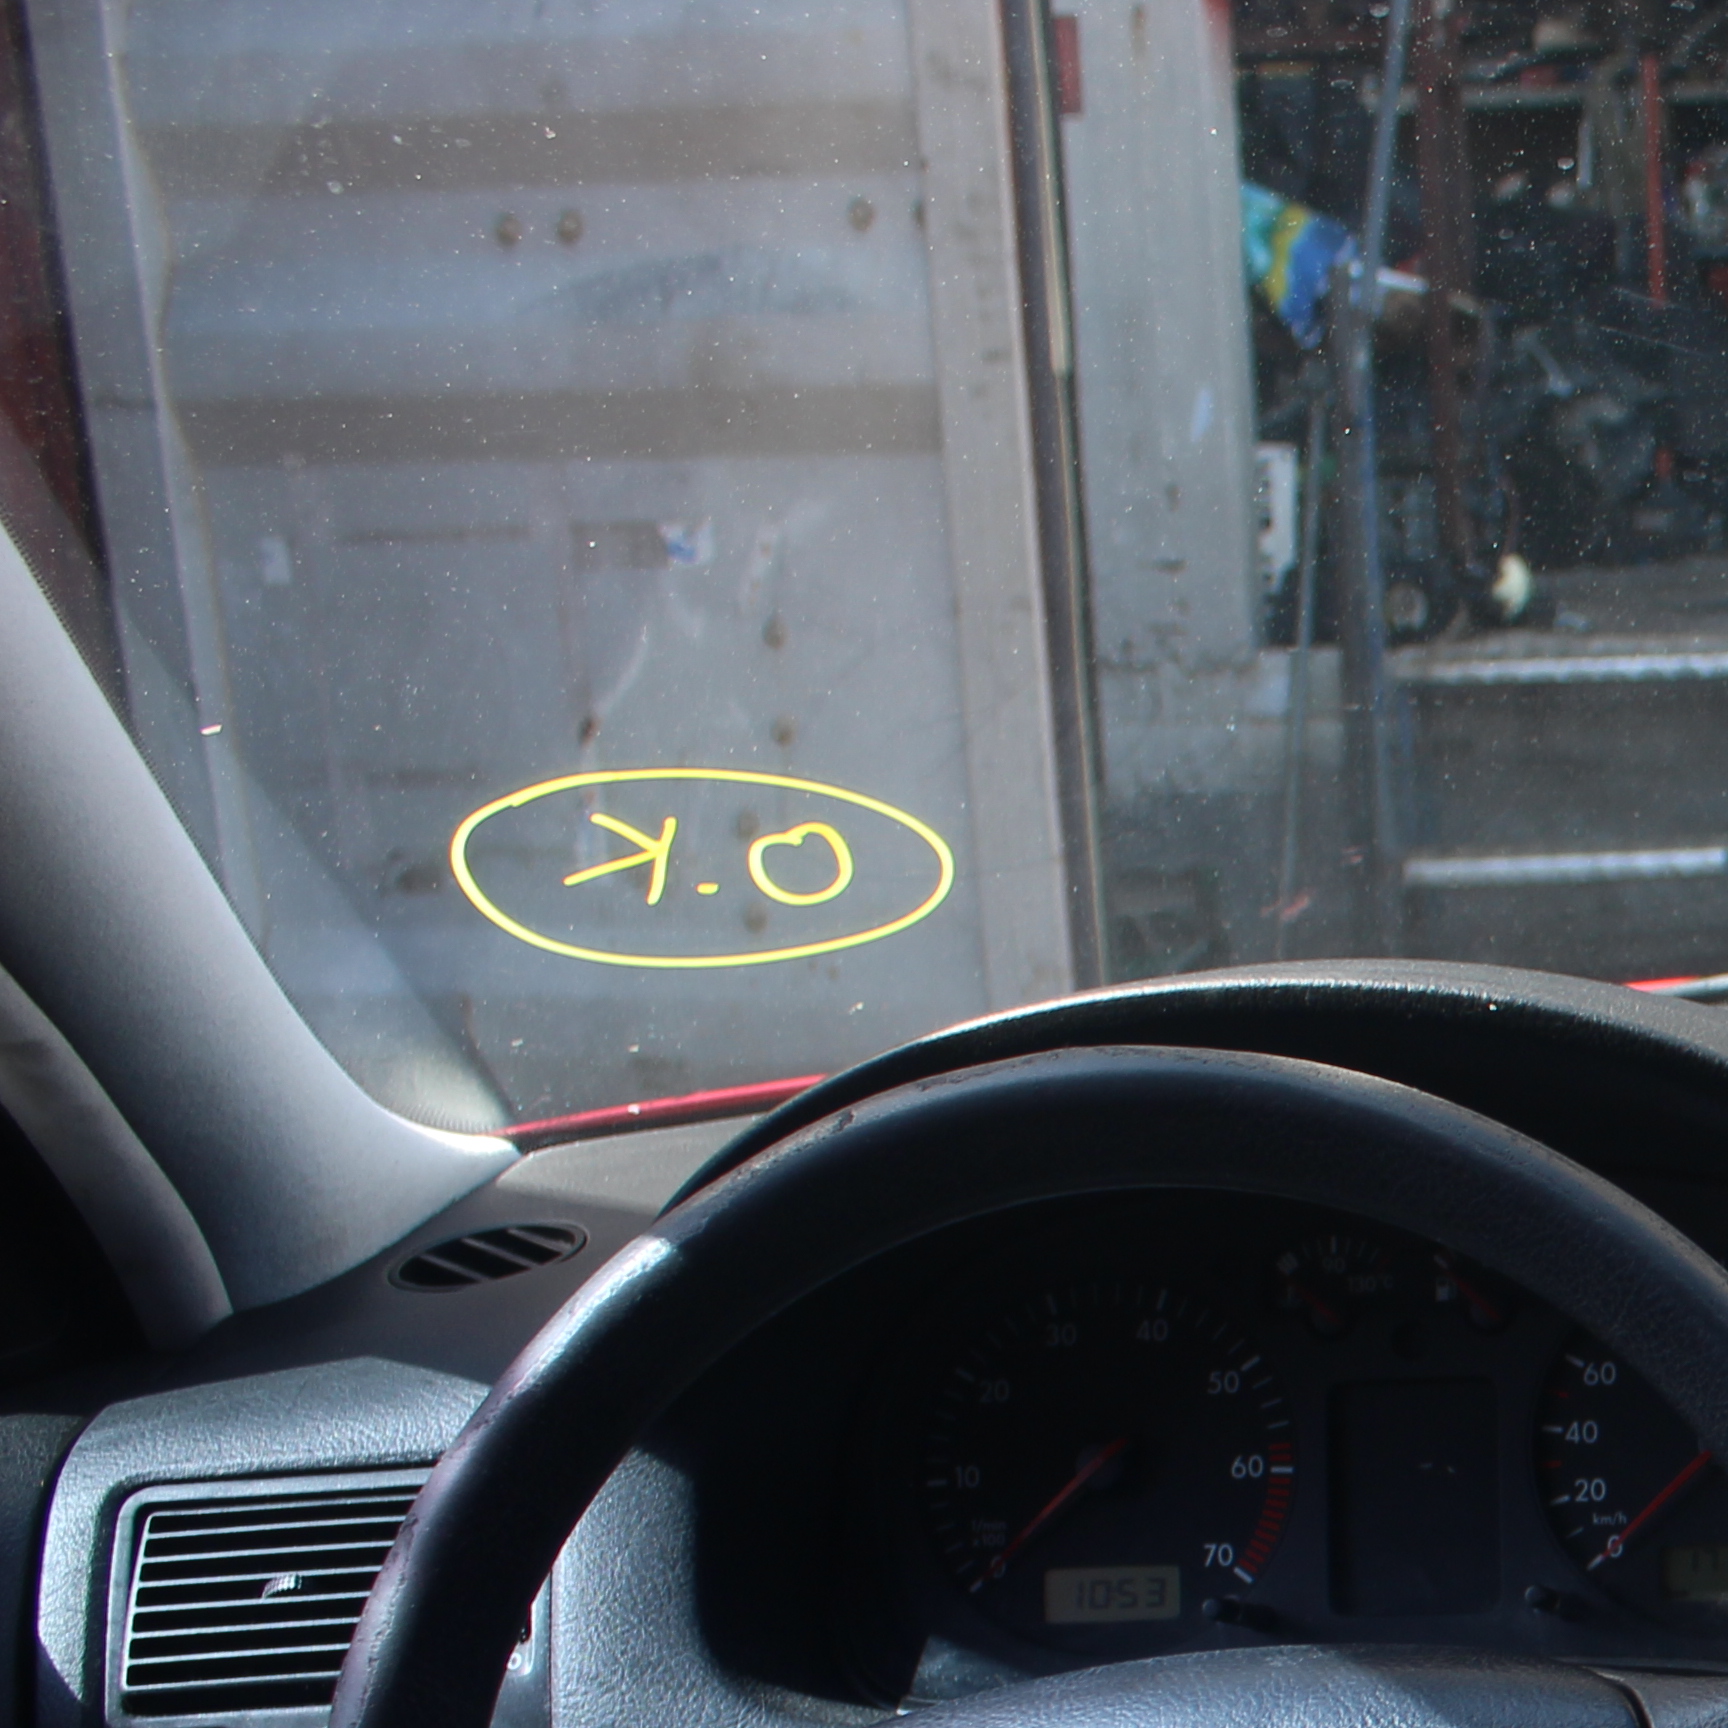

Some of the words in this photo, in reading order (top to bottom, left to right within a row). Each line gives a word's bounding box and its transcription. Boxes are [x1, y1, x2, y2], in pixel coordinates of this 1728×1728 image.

[1045, 1323, 1077, 1347] 30
[1136, 1319, 1169, 1343] 40
[1208, 1371, 1240, 1395] 50
[1583, 1362, 1616, 1386] 60
[979, 1380, 1011, 1404] 20
[1565, 1421, 1599, 1445] 40
[955, 1465, 980, 1490] 10
[1231, 1455, 1264, 1479] 60
[1575, 1478, 1607, 1503] 20
[1592, 1511, 1628, 1527] km/h
[1203, 1543, 1234, 1568] 70
[1607, 1534, 1623, 1559] 0
